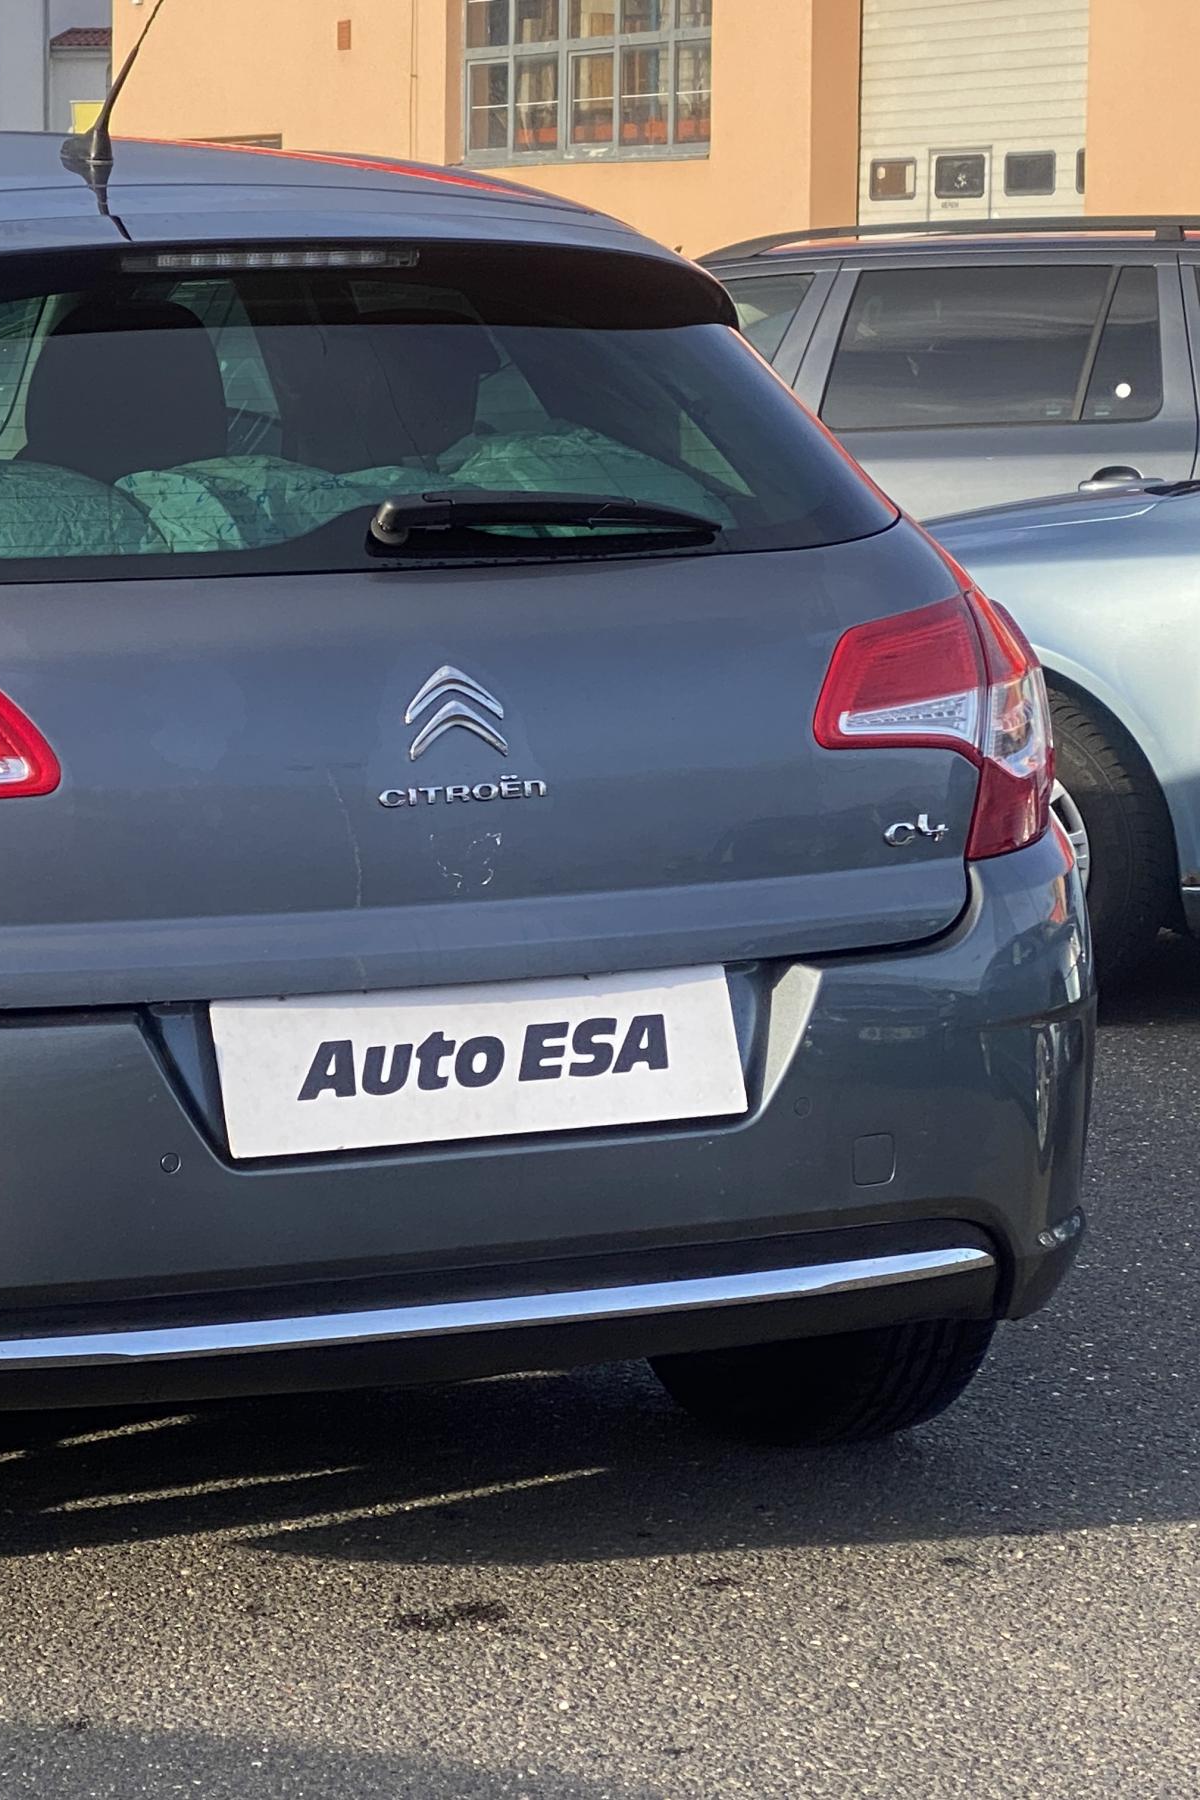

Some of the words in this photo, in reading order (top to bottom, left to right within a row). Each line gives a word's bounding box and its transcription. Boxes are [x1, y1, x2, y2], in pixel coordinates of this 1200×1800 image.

[883, 814, 949, 846] C4
[297, 1030, 505, 1101] Auto
[518, 1013, 669, 1082] ESA
